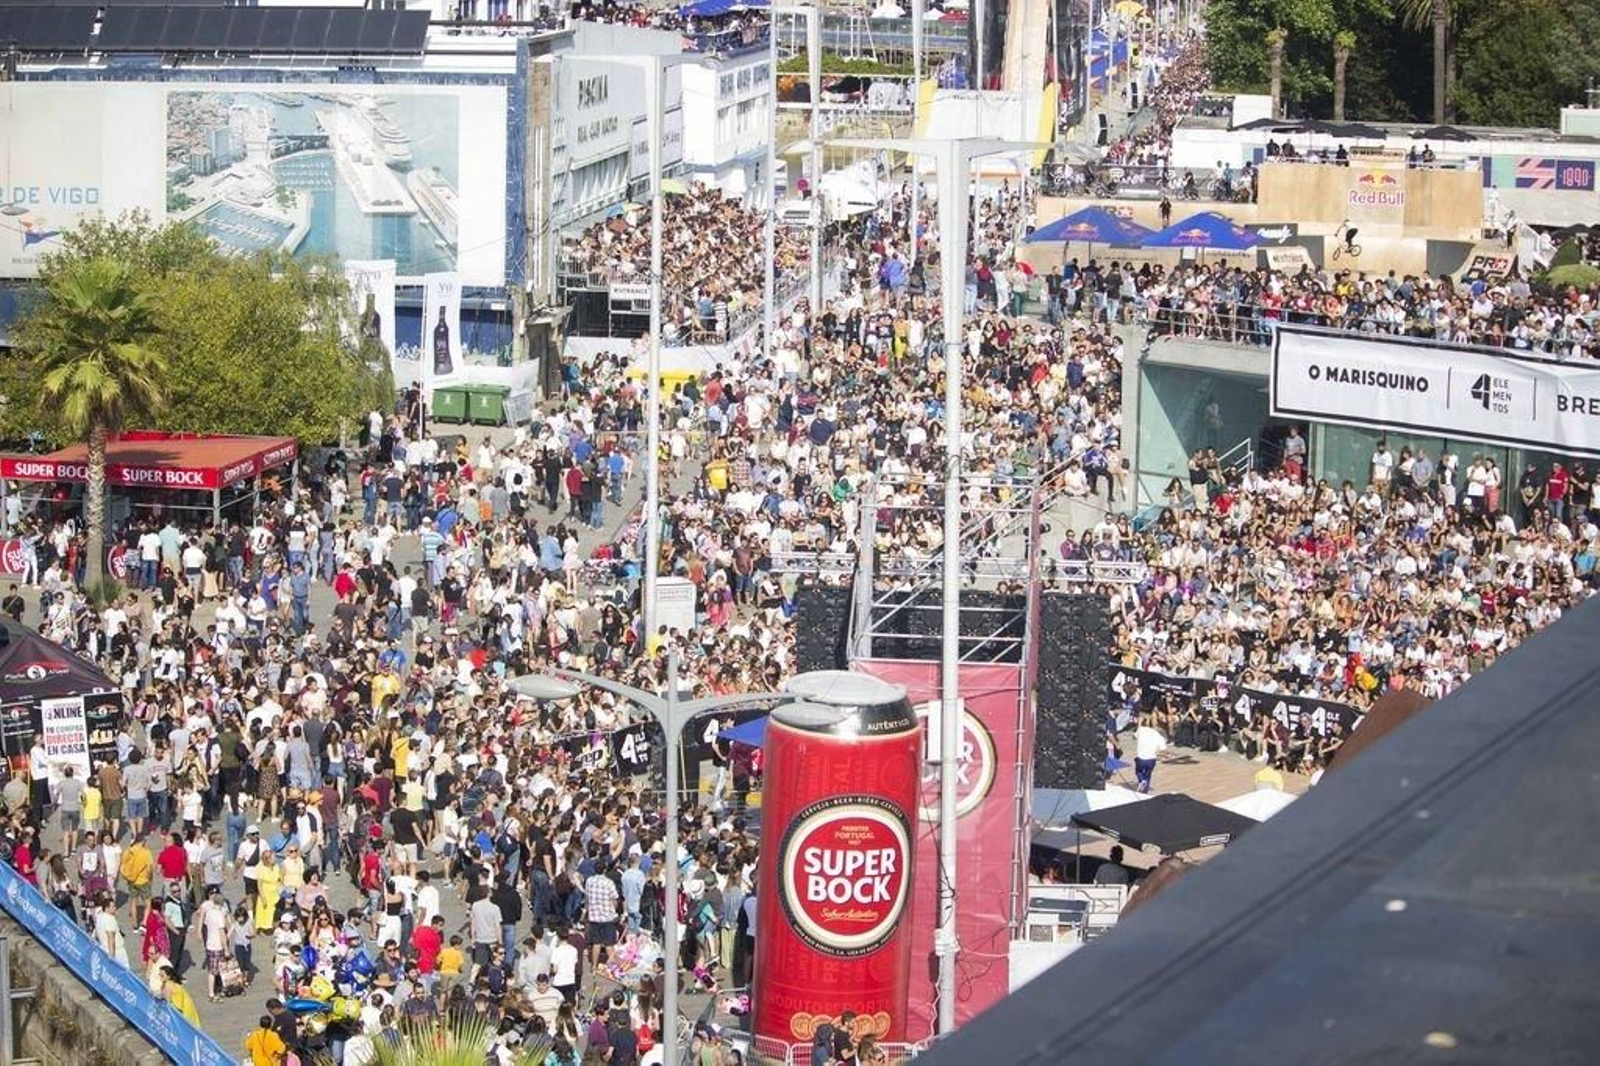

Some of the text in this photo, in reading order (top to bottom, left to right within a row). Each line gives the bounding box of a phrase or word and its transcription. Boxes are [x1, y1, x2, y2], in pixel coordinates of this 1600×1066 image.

[14, 187, 39, 204] DE
[49, 187, 99, 204] VIGO
[1350, 190, 1404, 205] Red Bull
[1308, 365, 1429, 393] O MARISQUINO
[1493, 378, 1509, 389] ELE
[1471, 373, 1491, 410] 4
[1492, 391, 1512, 402] MEN
[1493, 403, 1509, 413] TOS
[14, 462, 54, 477] SUPER
[122, 468, 204, 485] SUPER BOCK
[48, 746, 58, 755] EN
[61, 744, 86, 754] CASA
[621, 734, 638, 764] 4
[804, 847, 896, 876] SUPER
[807, 874, 891, 904] BOCK
